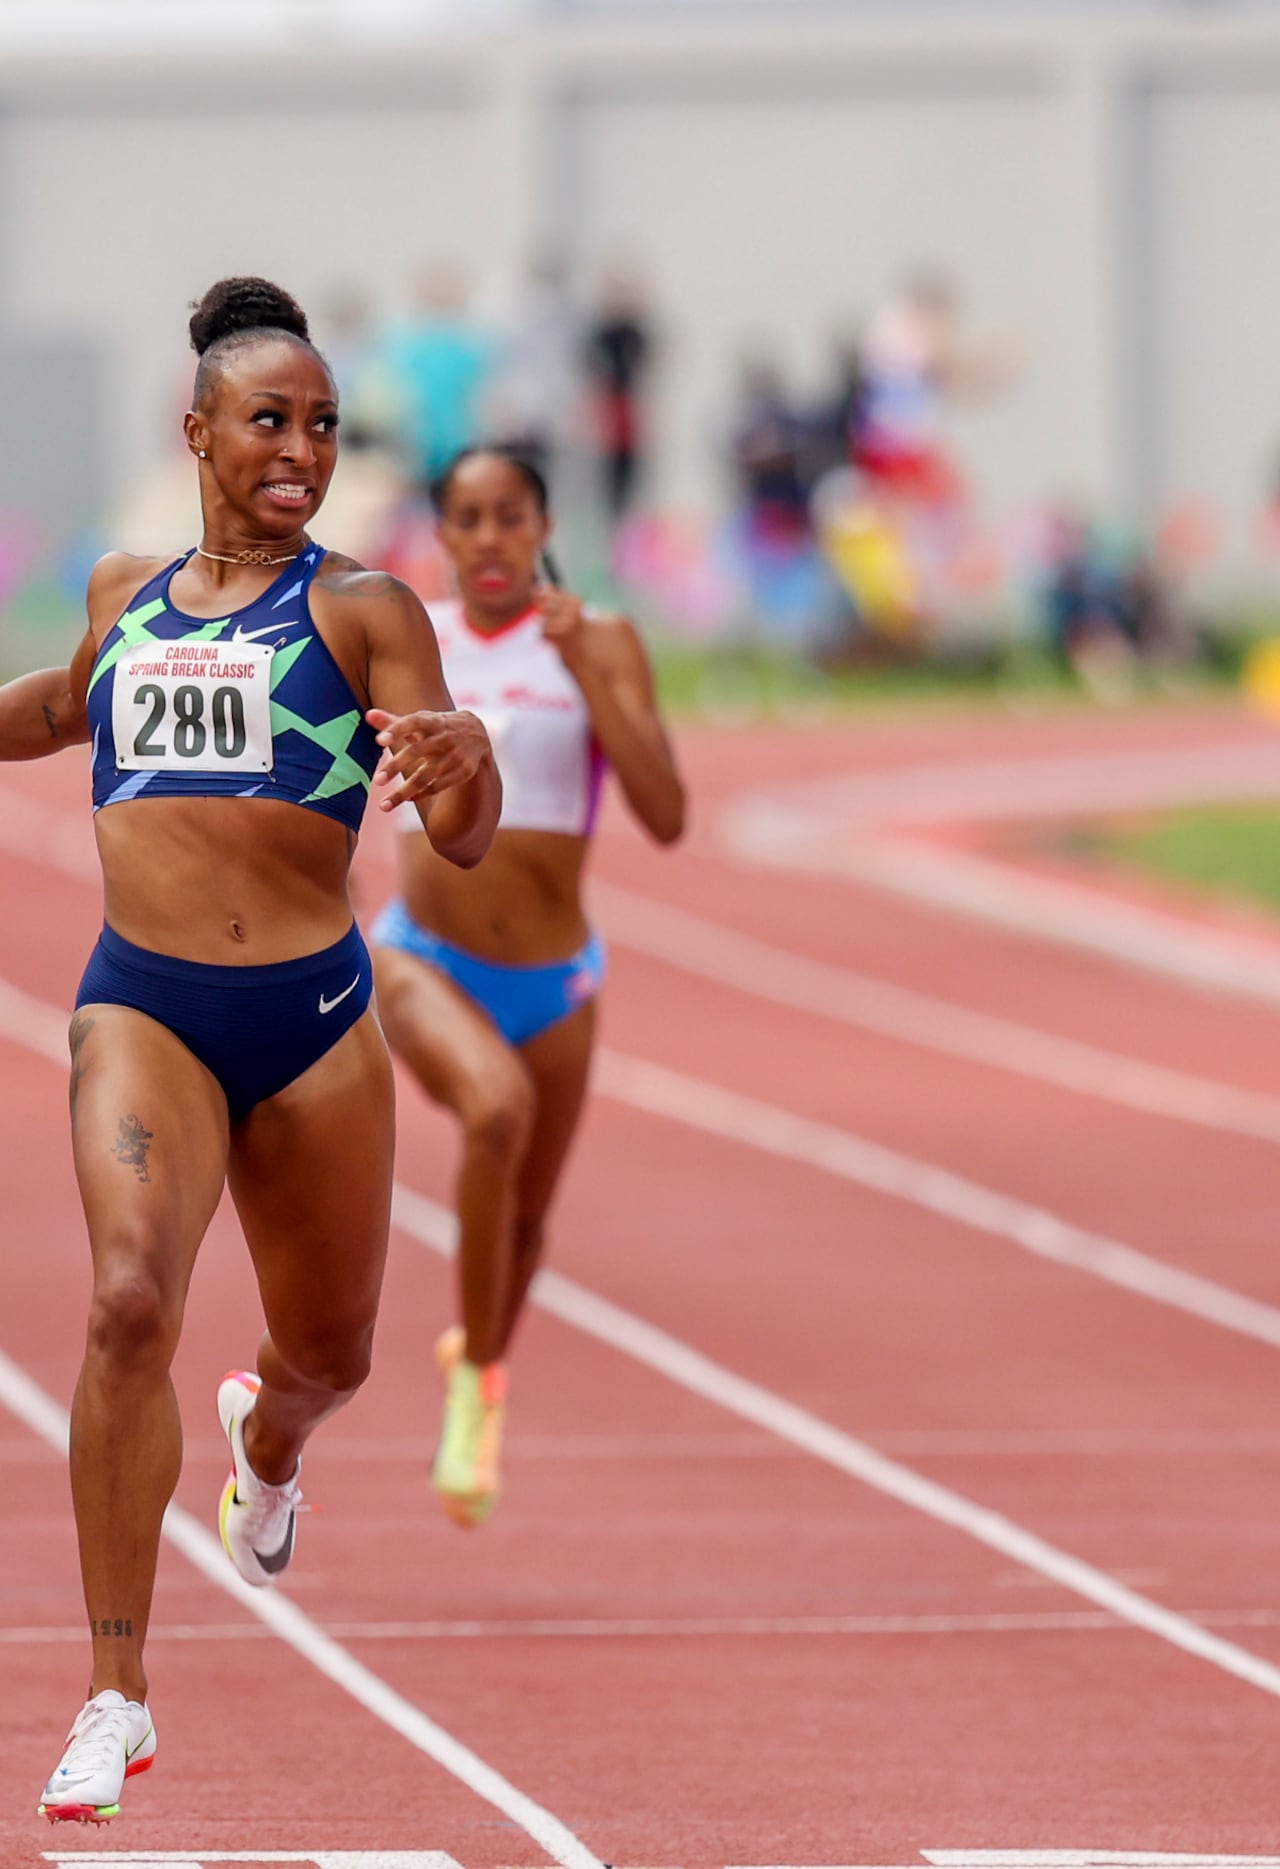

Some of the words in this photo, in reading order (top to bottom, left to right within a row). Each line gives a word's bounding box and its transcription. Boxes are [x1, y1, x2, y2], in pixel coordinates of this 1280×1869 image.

[165, 647, 218, 661] CAROLINA
[129, 662, 168, 677] SPRING
[171, 663, 206, 678] BREAK
[209, 663, 255, 679] CLASSIC
[133, 684, 246, 758] 280
